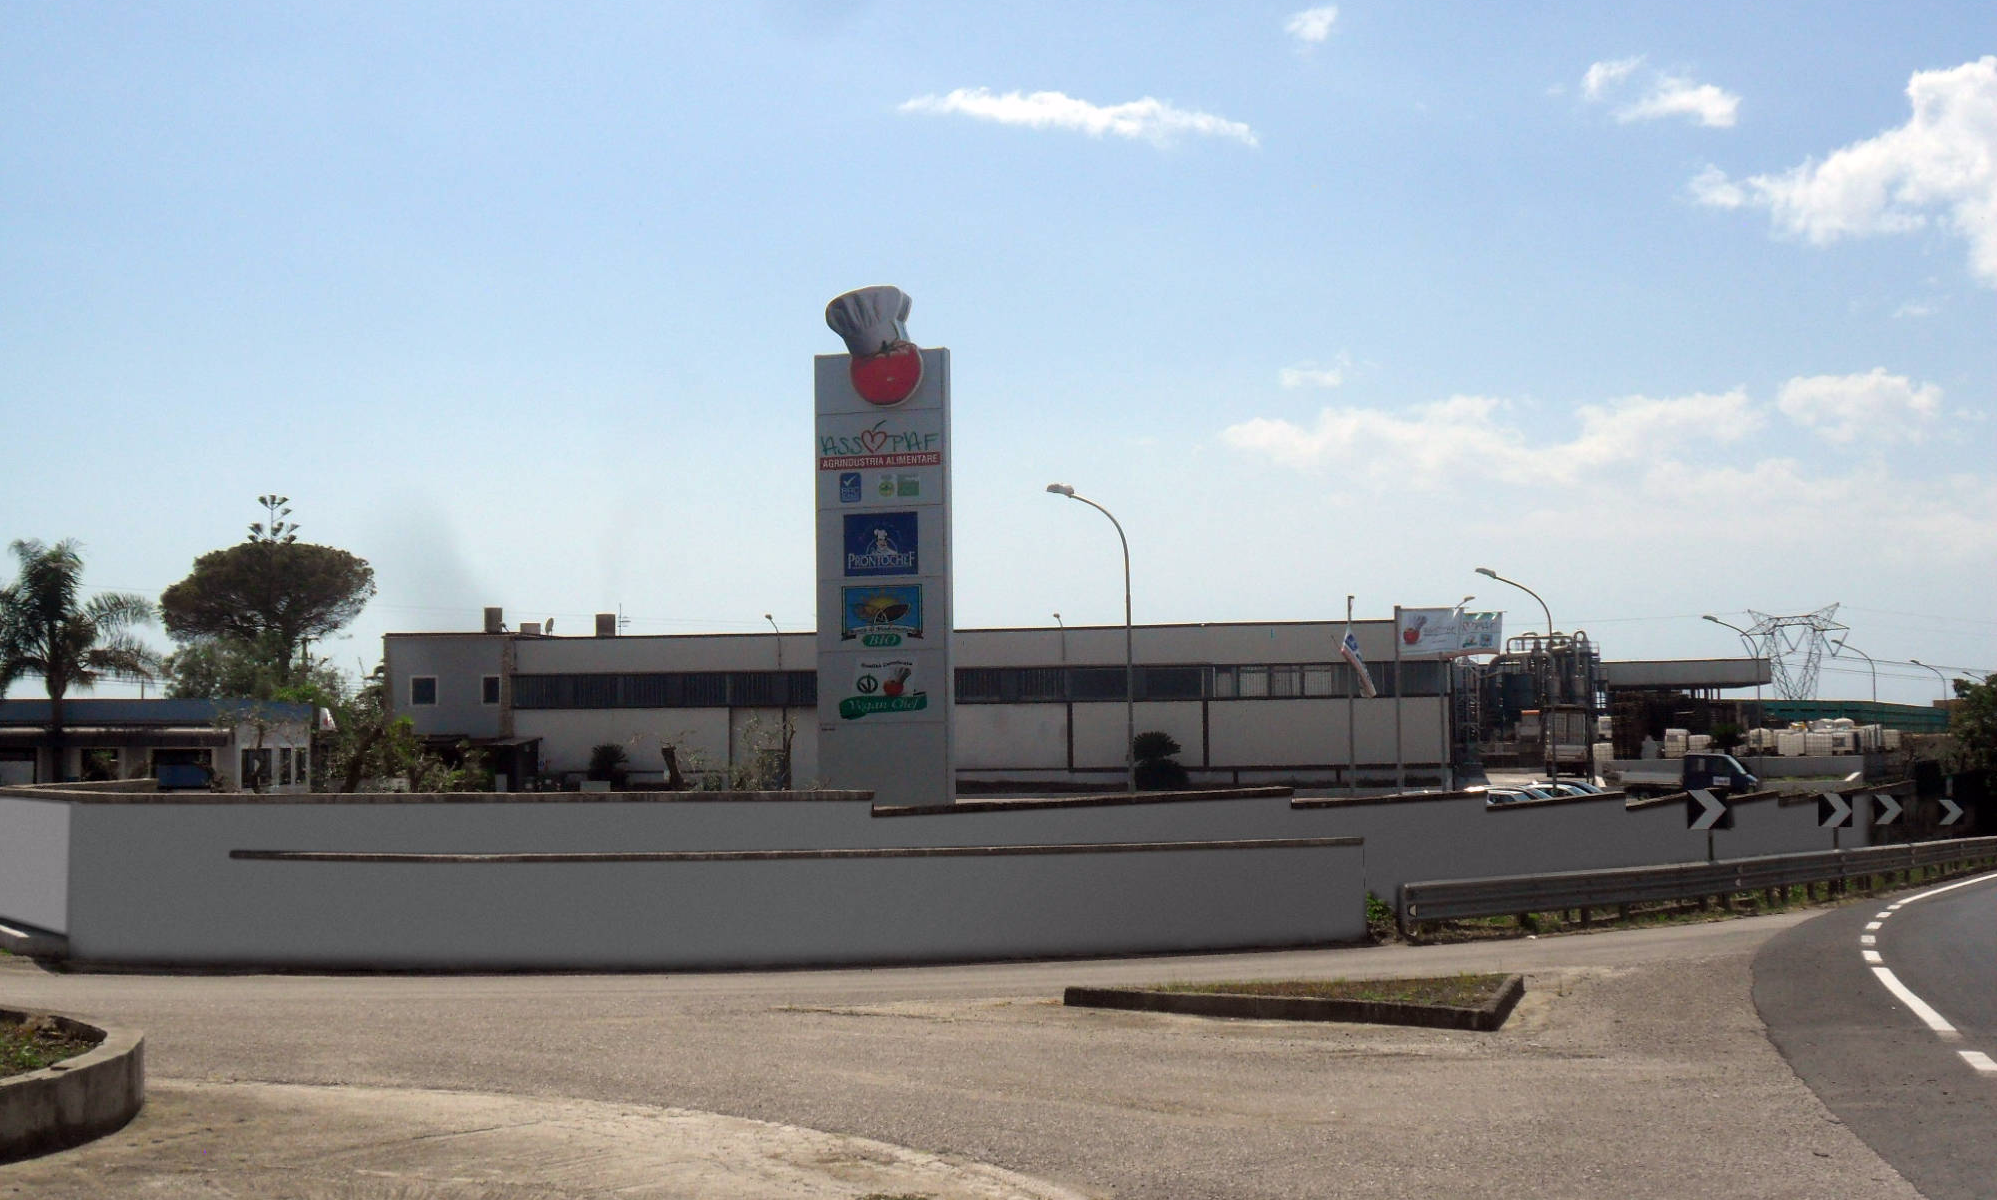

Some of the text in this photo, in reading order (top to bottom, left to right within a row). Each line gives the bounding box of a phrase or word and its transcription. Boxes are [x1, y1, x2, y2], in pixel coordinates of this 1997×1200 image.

[822, 453, 939, 469] AGRINDUSTRIA ALIMENTARE
[848, 551, 915, 569] PRONTOCHEF
[869, 634, 897, 646] BIO
[849, 697, 918, 712] Vegan Chef
